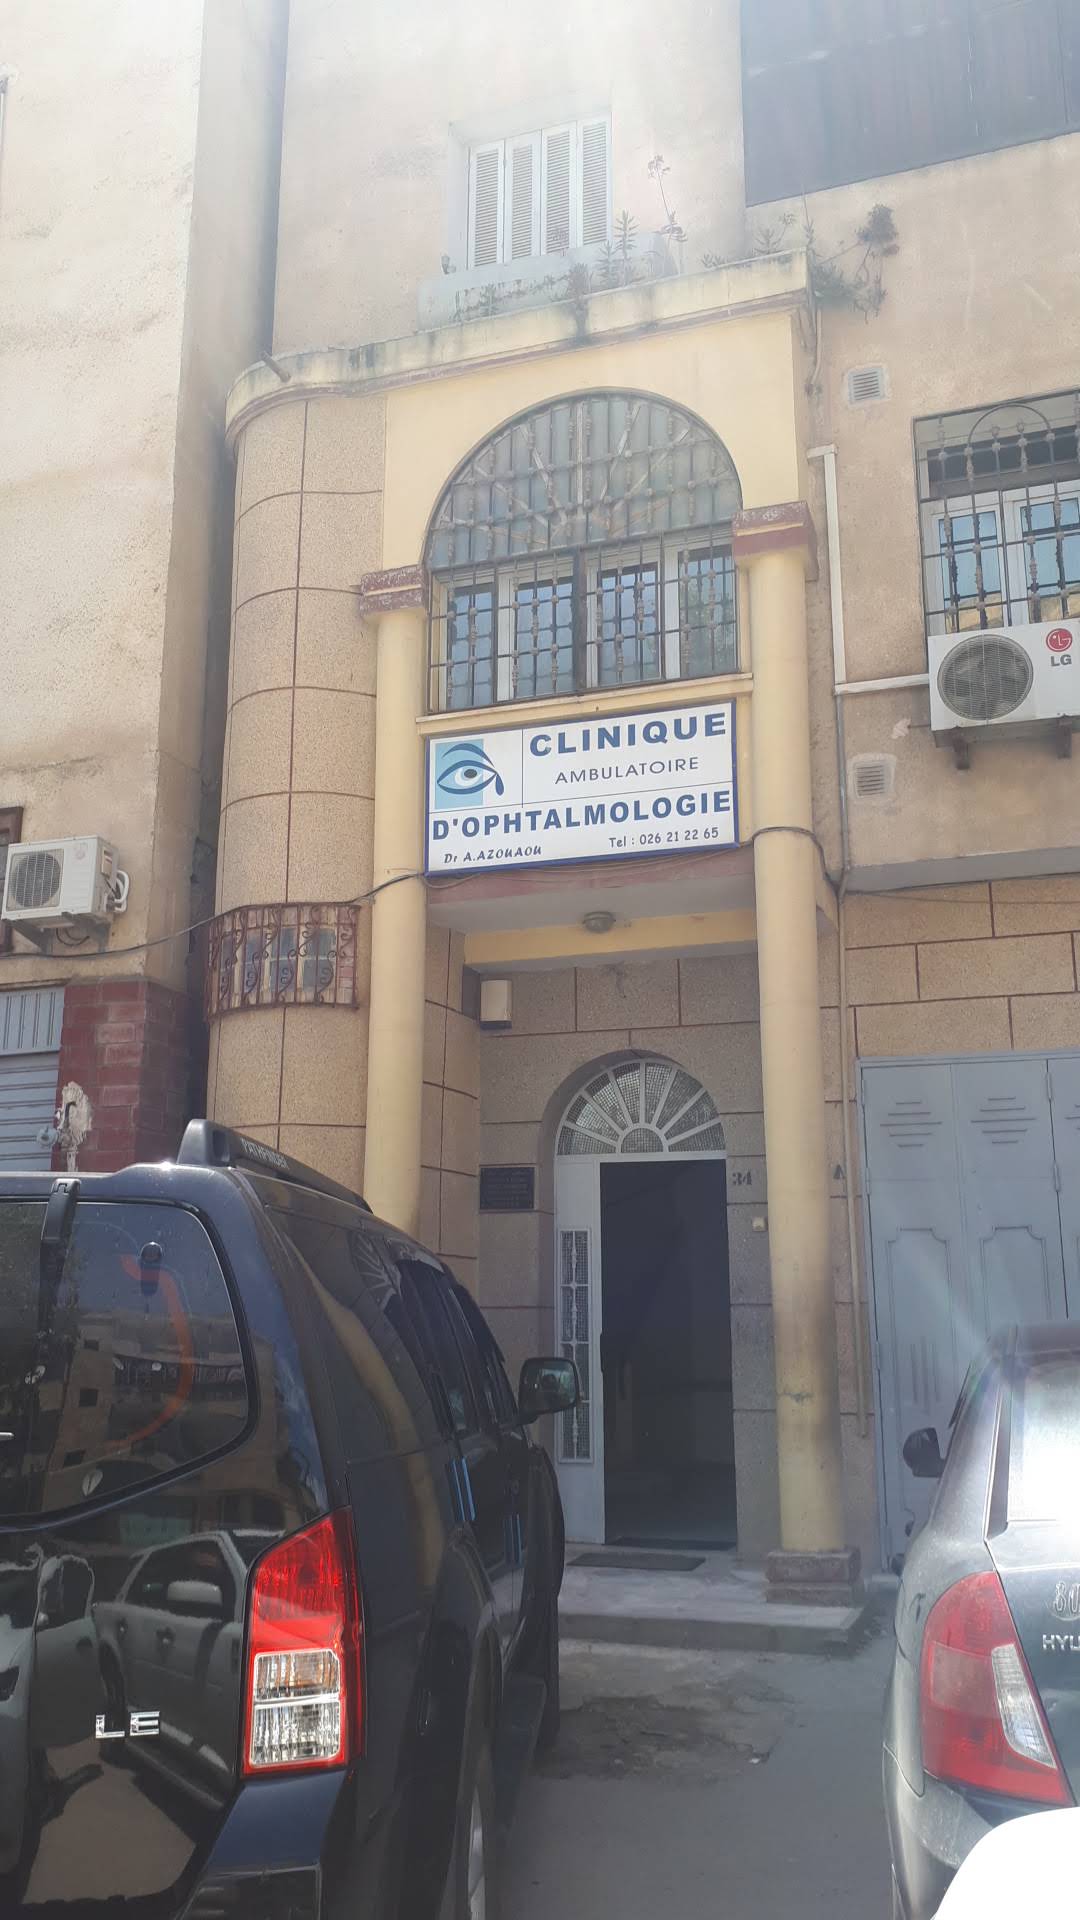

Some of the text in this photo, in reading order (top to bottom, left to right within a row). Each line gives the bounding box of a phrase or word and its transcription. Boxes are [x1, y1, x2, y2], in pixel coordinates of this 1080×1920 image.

[1050, 654, 1072, 667] LG
[530, 712, 726, 757] CLINIQUE
[555, 757, 699, 785] AMBULATOIRE
[432, 790, 731, 841] D'OPHTALMOLOGIE
[608, 836, 627, 848] Tel
[639, 833, 661, 845] 026
[666, 831, 679, 842] 21
[684, 829, 698, 840] 22
[703, 827, 719, 839] 65
[444, 853, 458, 864] Dr
